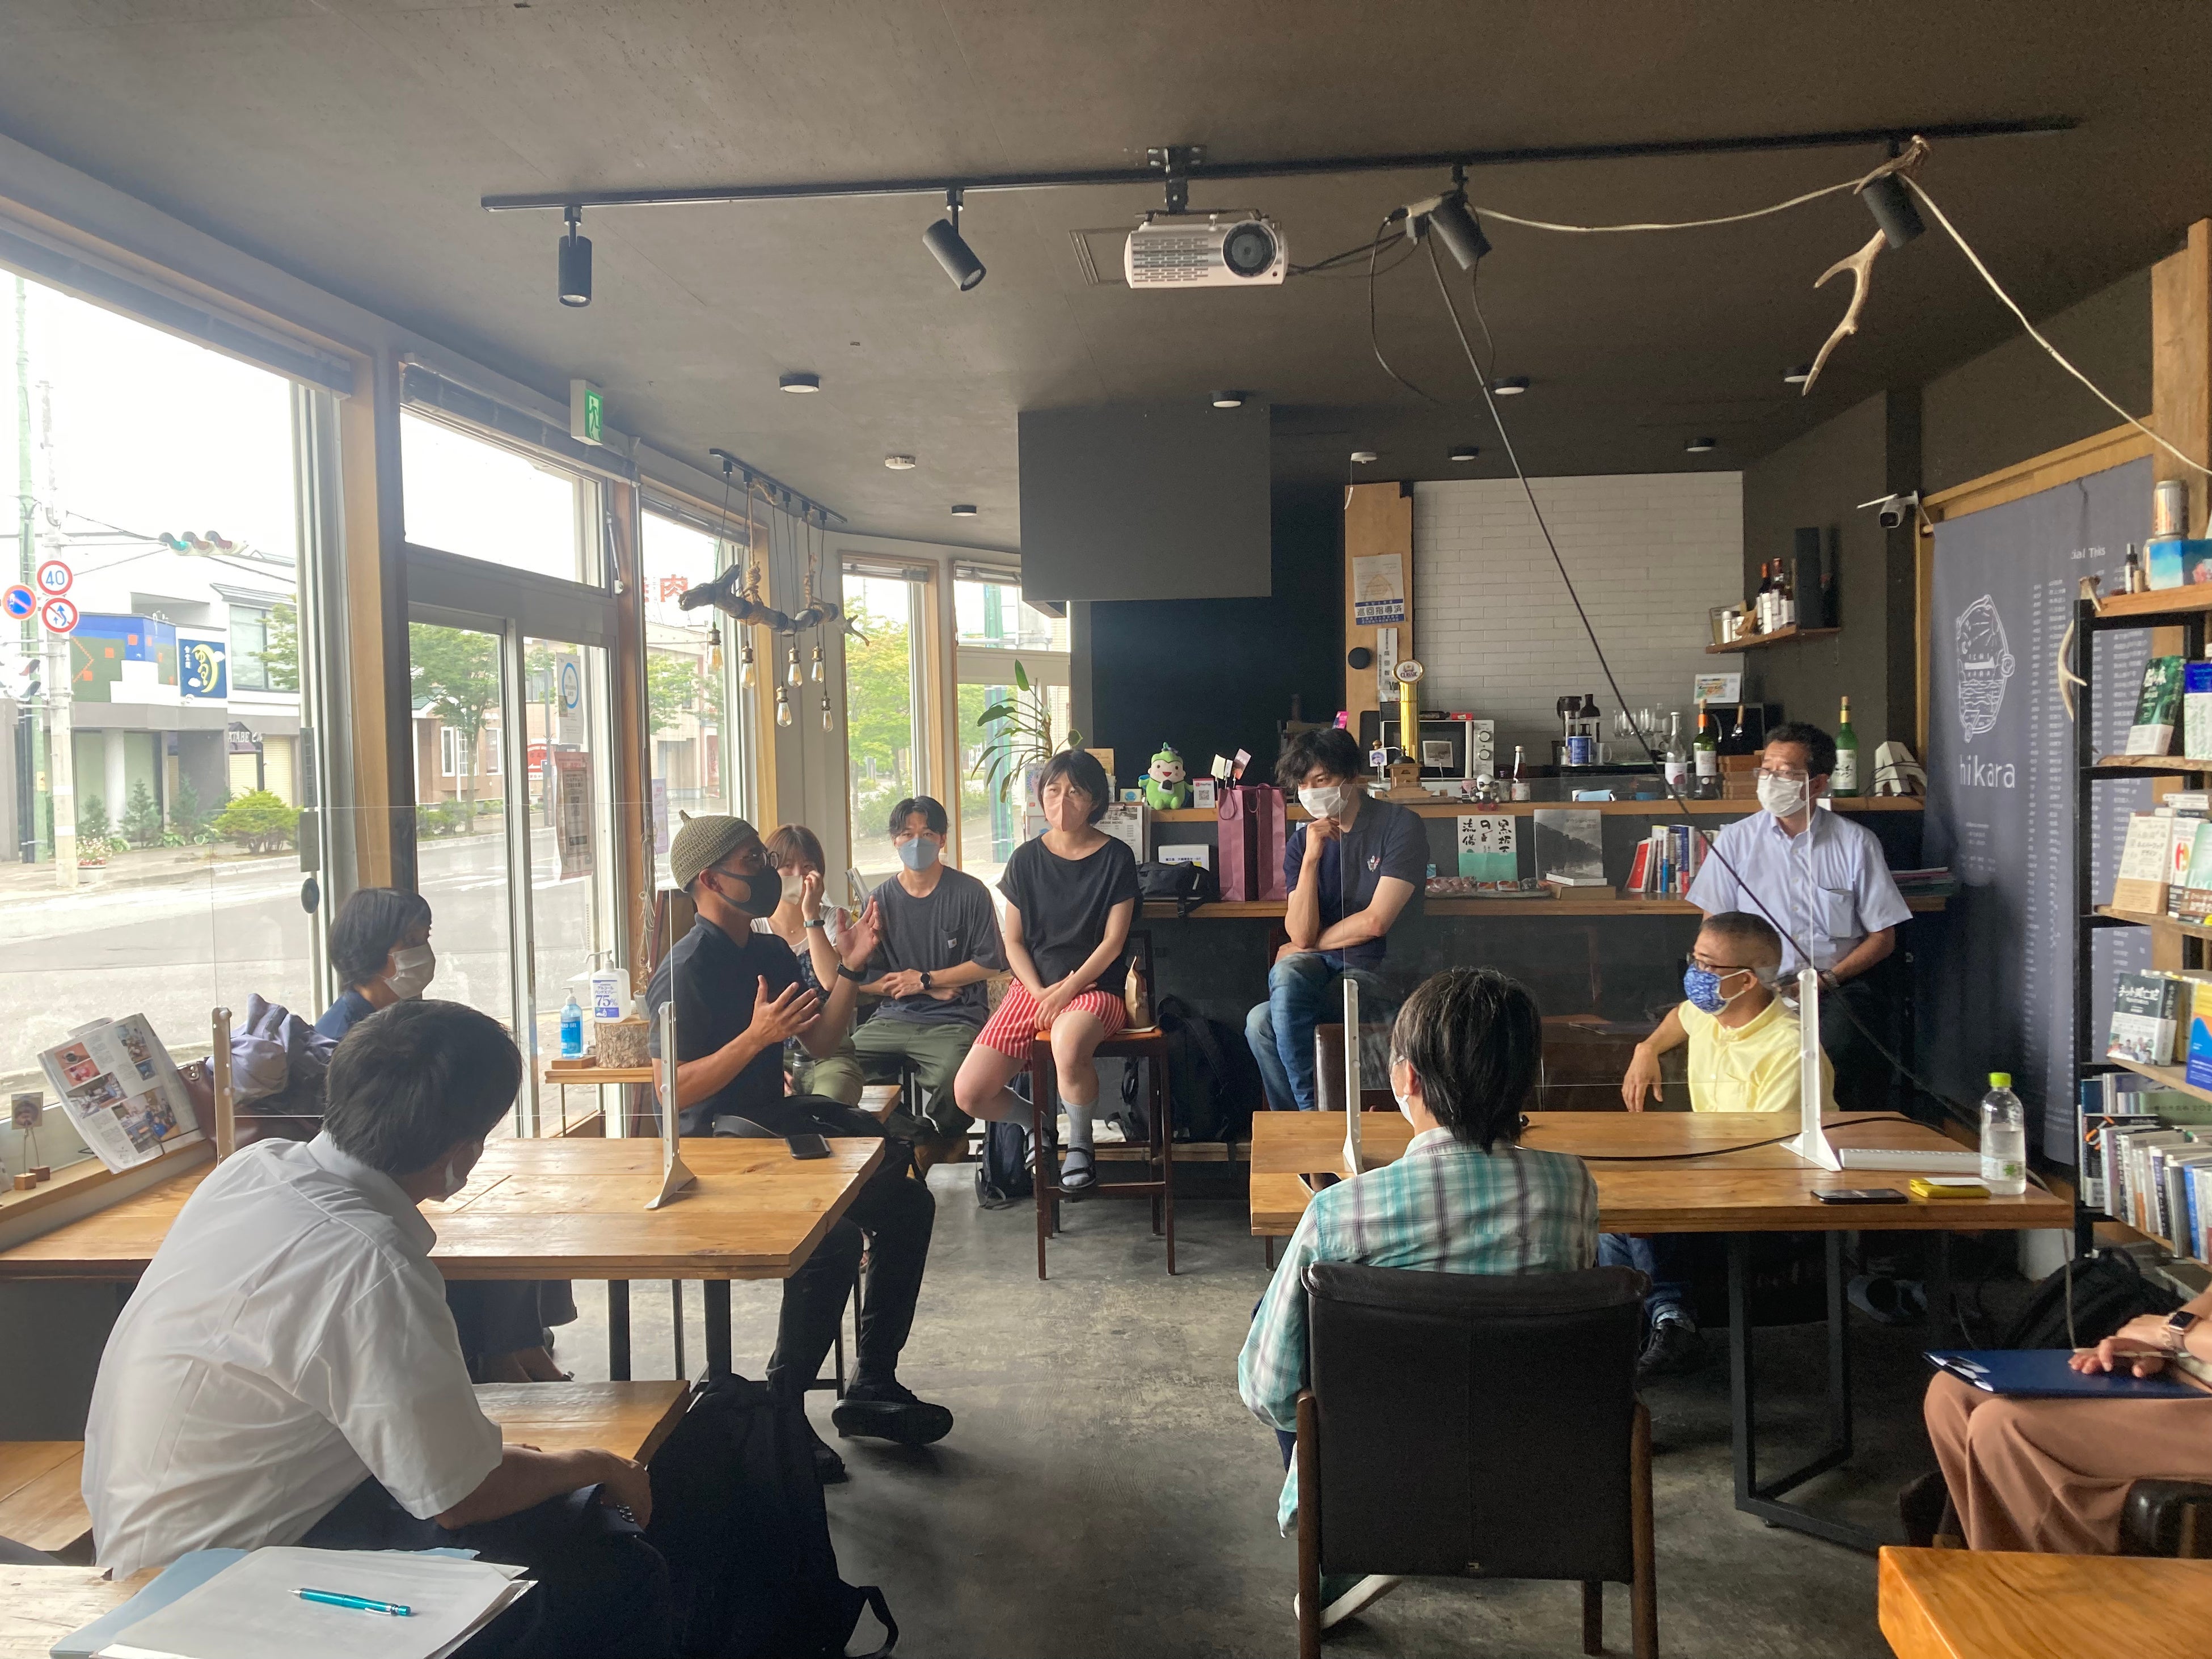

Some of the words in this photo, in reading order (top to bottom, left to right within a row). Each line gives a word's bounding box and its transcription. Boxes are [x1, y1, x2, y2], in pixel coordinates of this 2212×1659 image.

[46, 570, 65, 585] 40
[644, 574, 688, 602] 肉
[596, 995, 618, 1006] 75%
